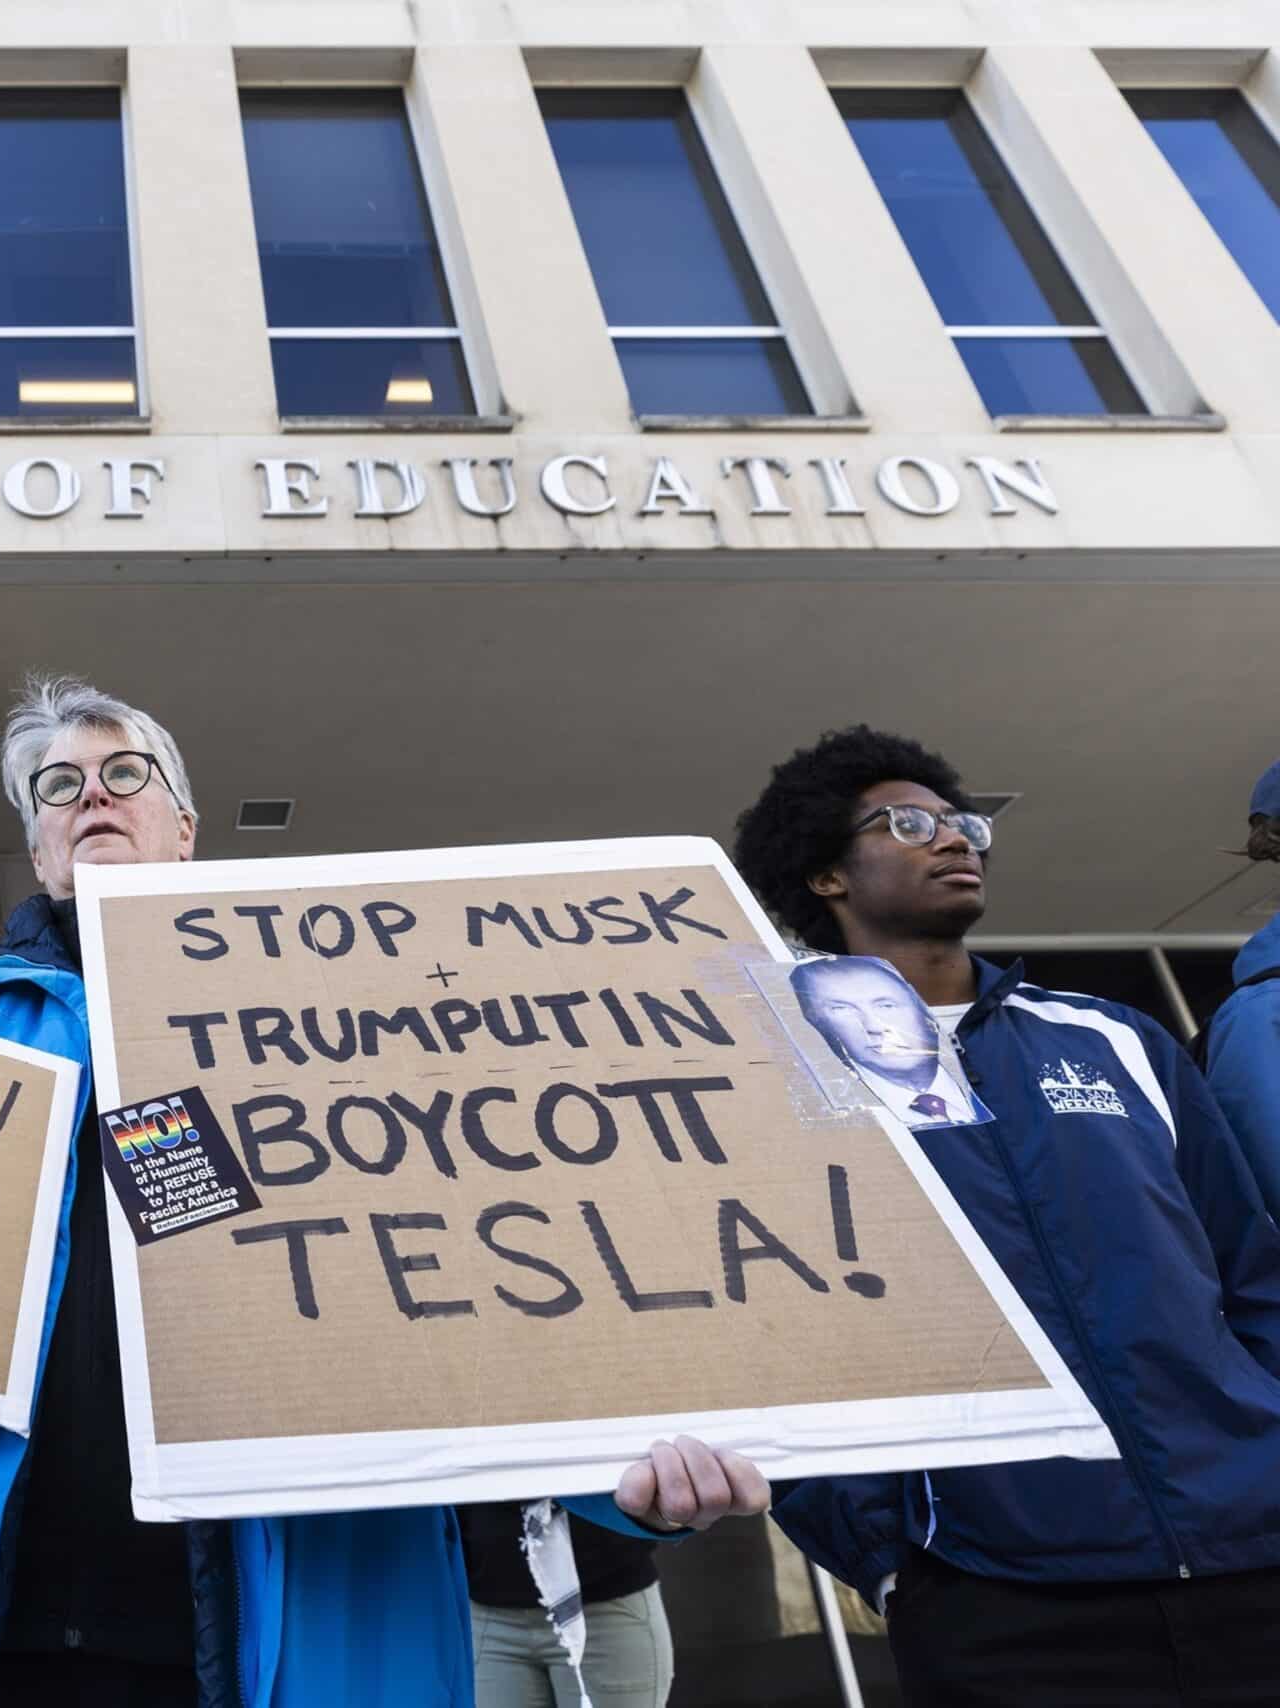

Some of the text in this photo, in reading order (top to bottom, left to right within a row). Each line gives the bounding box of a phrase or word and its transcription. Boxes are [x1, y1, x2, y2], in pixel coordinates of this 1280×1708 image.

[2, 458, 165, 521] OF
[254, 455, 1060, 519] EDUCATION
[174, 886, 728, 962] STOP MUSK
[168, 987, 736, 1070] TRUMPUTIN
[1044, 1088, 1085, 1100] HOYA
[1051, 1099, 1126, 1113] WEEKEND
[104, 1096, 201, 1162] NO!
[232, 1076, 734, 1188] BOYCOTT
[130, 1146, 203, 1174] In the Name
[135, 1156, 208, 1185] of Humanity
[139, 1166, 217, 1197] We REFUSE
[149, 1180, 219, 1208] to Accept a
[139, 1186, 238, 1224] Fascist America
[231, 1164, 887, 1321] TESLA!
